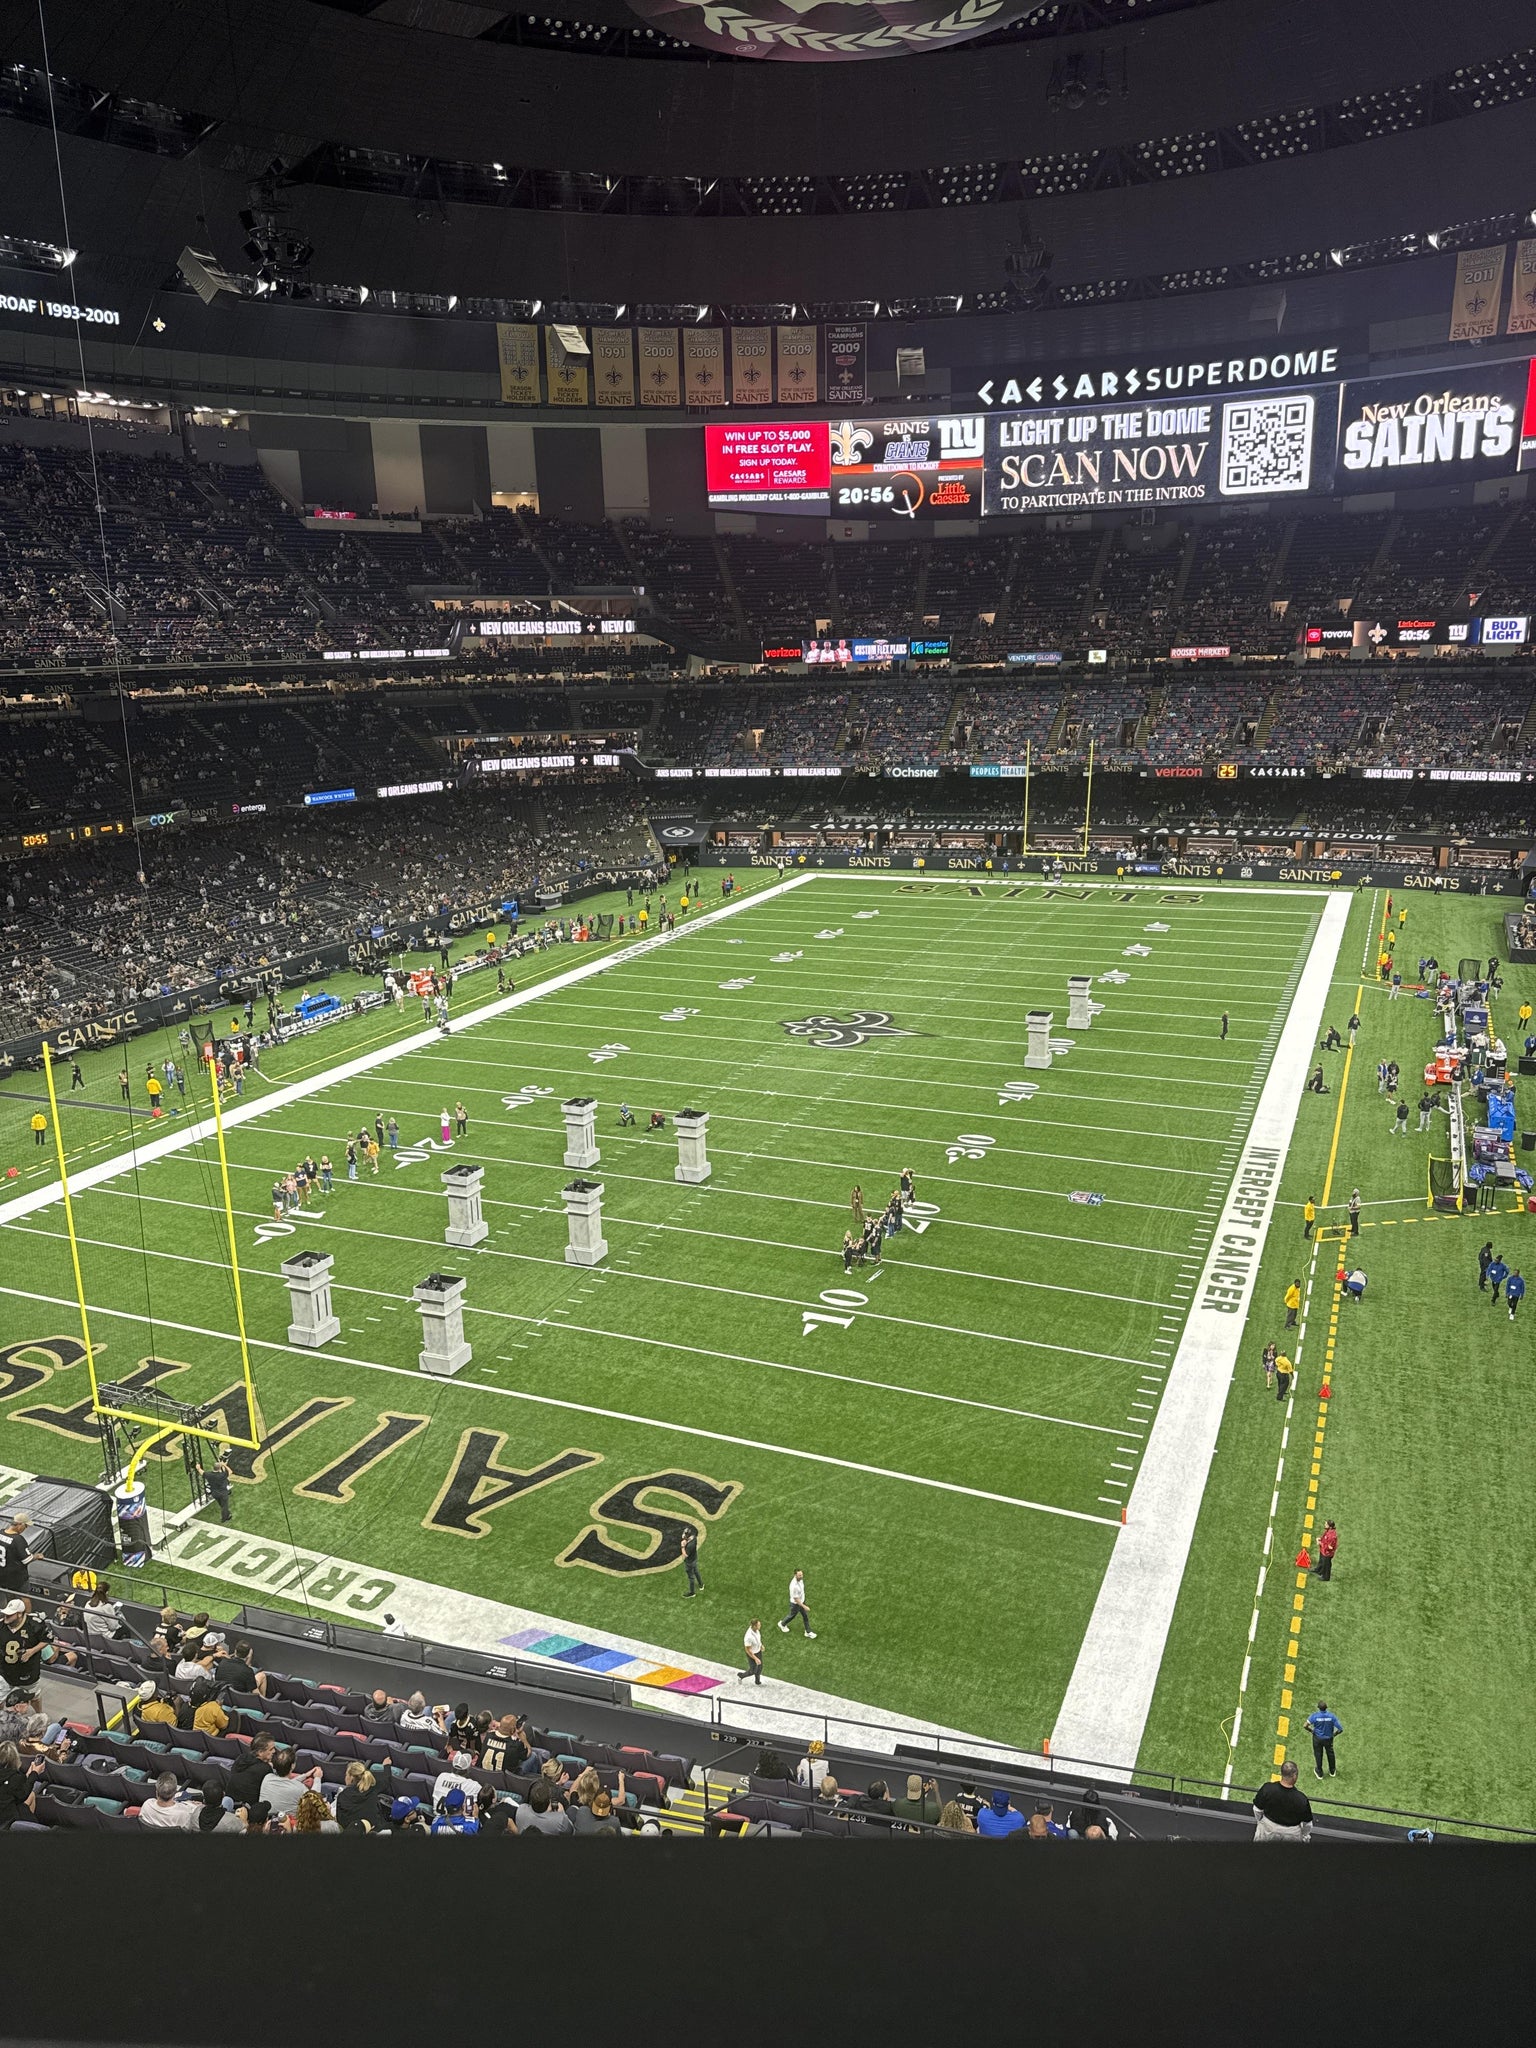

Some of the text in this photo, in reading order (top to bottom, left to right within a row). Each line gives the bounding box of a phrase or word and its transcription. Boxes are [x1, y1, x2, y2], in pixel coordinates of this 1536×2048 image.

[1464, 268, 1495, 284] 2011
[46, 302, 120, 326] 1993-2001
[1453, 325, 1494, 338] SAINTS
[600, 347, 626, 358] 1991
[644, 346, 674, 357] 2000
[689, 347, 718, 358] 2006
[737, 345, 766, 356] 2009
[783, 345, 812, 355] 2009
[832, 343, 860, 353] 2009
[978, 349, 1338, 405] CAESARS SUPERDOME
[598, 395, 632, 404] SAINTS
[643, 395, 677, 404] SAINTS
[688, 395, 722, 404] SAINTS
[736, 393, 769, 402] SAINTS
[781, 392, 815, 401] SAINTS
[829, 390, 863, 400] SAINTS
[1361, 391, 1501, 423] New Orleans
[883, 421, 930, 435] SAINTS
[1000, 406, 1211, 447] LIGHT UP THE DOME
[725, 430, 811, 441] WIN UP TO $5,000
[1344, 404, 1515, 470] SAINTS
[722, 443, 814, 454] IN FREE SLOT PLAY.
[884, 441, 931, 460] GIANTS
[771, 458, 798, 466] TODAY.
[1000, 442, 1209, 490] SCAN NOW
[937, 482, 966, 495] Little
[769, 493, 783, 501] CALL
[839, 486, 895, 504] 20:56
[929, 493, 971, 505] Caesars
[1001, 484, 1205, 510] TO PARTICIPATE IN THE INTROS
[480, 620, 582, 635] NEW ORLEANS SAINTS
[601, 620, 624, 634] NEW
[1491, 621, 1518, 631] BUD
[1322, 631, 1352, 639] TOYOTA
[1399, 630, 1430, 641] 20:56
[1486, 630, 1522, 641] LIGHT
[764, 647, 801, 658] verizon
[855, 644, 907, 655] CUSTOM FLEX PLANS
[1198, 648, 1230, 656] MARKETS
[102, 656, 132, 666] SAINTS
[165, 654, 194, 664] SAINTS
[224, 653, 252, 662] SAINTS
[281, 652, 307, 660] SAINTS
[34, 658, 67, 668] SAINTS
[482, 756, 575, 772] NEW ORLEANS SAINTS
[593, 755, 612, 766] NEW
[670, 769, 693, 777] SAINTS
[705, 768, 771, 777] NEW ORLEANS SAINTS
[783, 768, 825, 777] NEW ORLEANS
[892, 767, 938, 778] Ochsner
[971, 767, 1026, 776] PEOPLES HEALTH
[1155, 766, 1202, 777] verizon
[1220, 766, 1235, 777] 25
[1250, 768, 1305, 777] CAESARS
[1383, 769, 1413, 779] SAINTS
[1430, 770, 1521, 782] NEW ORLEANS SAINTS
[388, 781, 443, 797] ORLEANS SAINTS
[191, 808, 217, 817] SAINTS
[240, 804, 267, 813] entergy
[150, 813, 174, 826] COX
[84, 827, 91, 837] 0
[1139, 827, 1398, 841] CAESARS SUPERDOME
[23, 833, 48, 847] 20:55
[751, 855, 793, 867] SAINTS
[849, 857, 891, 867] SAINTS
[1279, 868, 1332, 882] SAINTS
[892, 883, 1204, 904] SAINTS
[659, 1007, 700, 1021] 50
[588, 1043, 631, 1059] 40
[501, 1085, 554, 1105] 30
[997, 1081, 1040, 1101] 40
[393, 1137, 455, 1162] 20
[945, 1134, 996, 1159] 30
[1201, 1146, 1281, 1314] INTERCEPT CANCER
[802, 1289, 869, 1329] 10
[0, 1335, 744, 1577] SAINTS
[5, 1640, 20, 1664] 9
[487, 1738, 507, 1750] KAMARA
[723, 1735, 737, 1743] 239
[482, 1748, 505, 1771] 41
[850, 1814, 867, 1823] 239
[890, 1820, 908, 1830] 237
